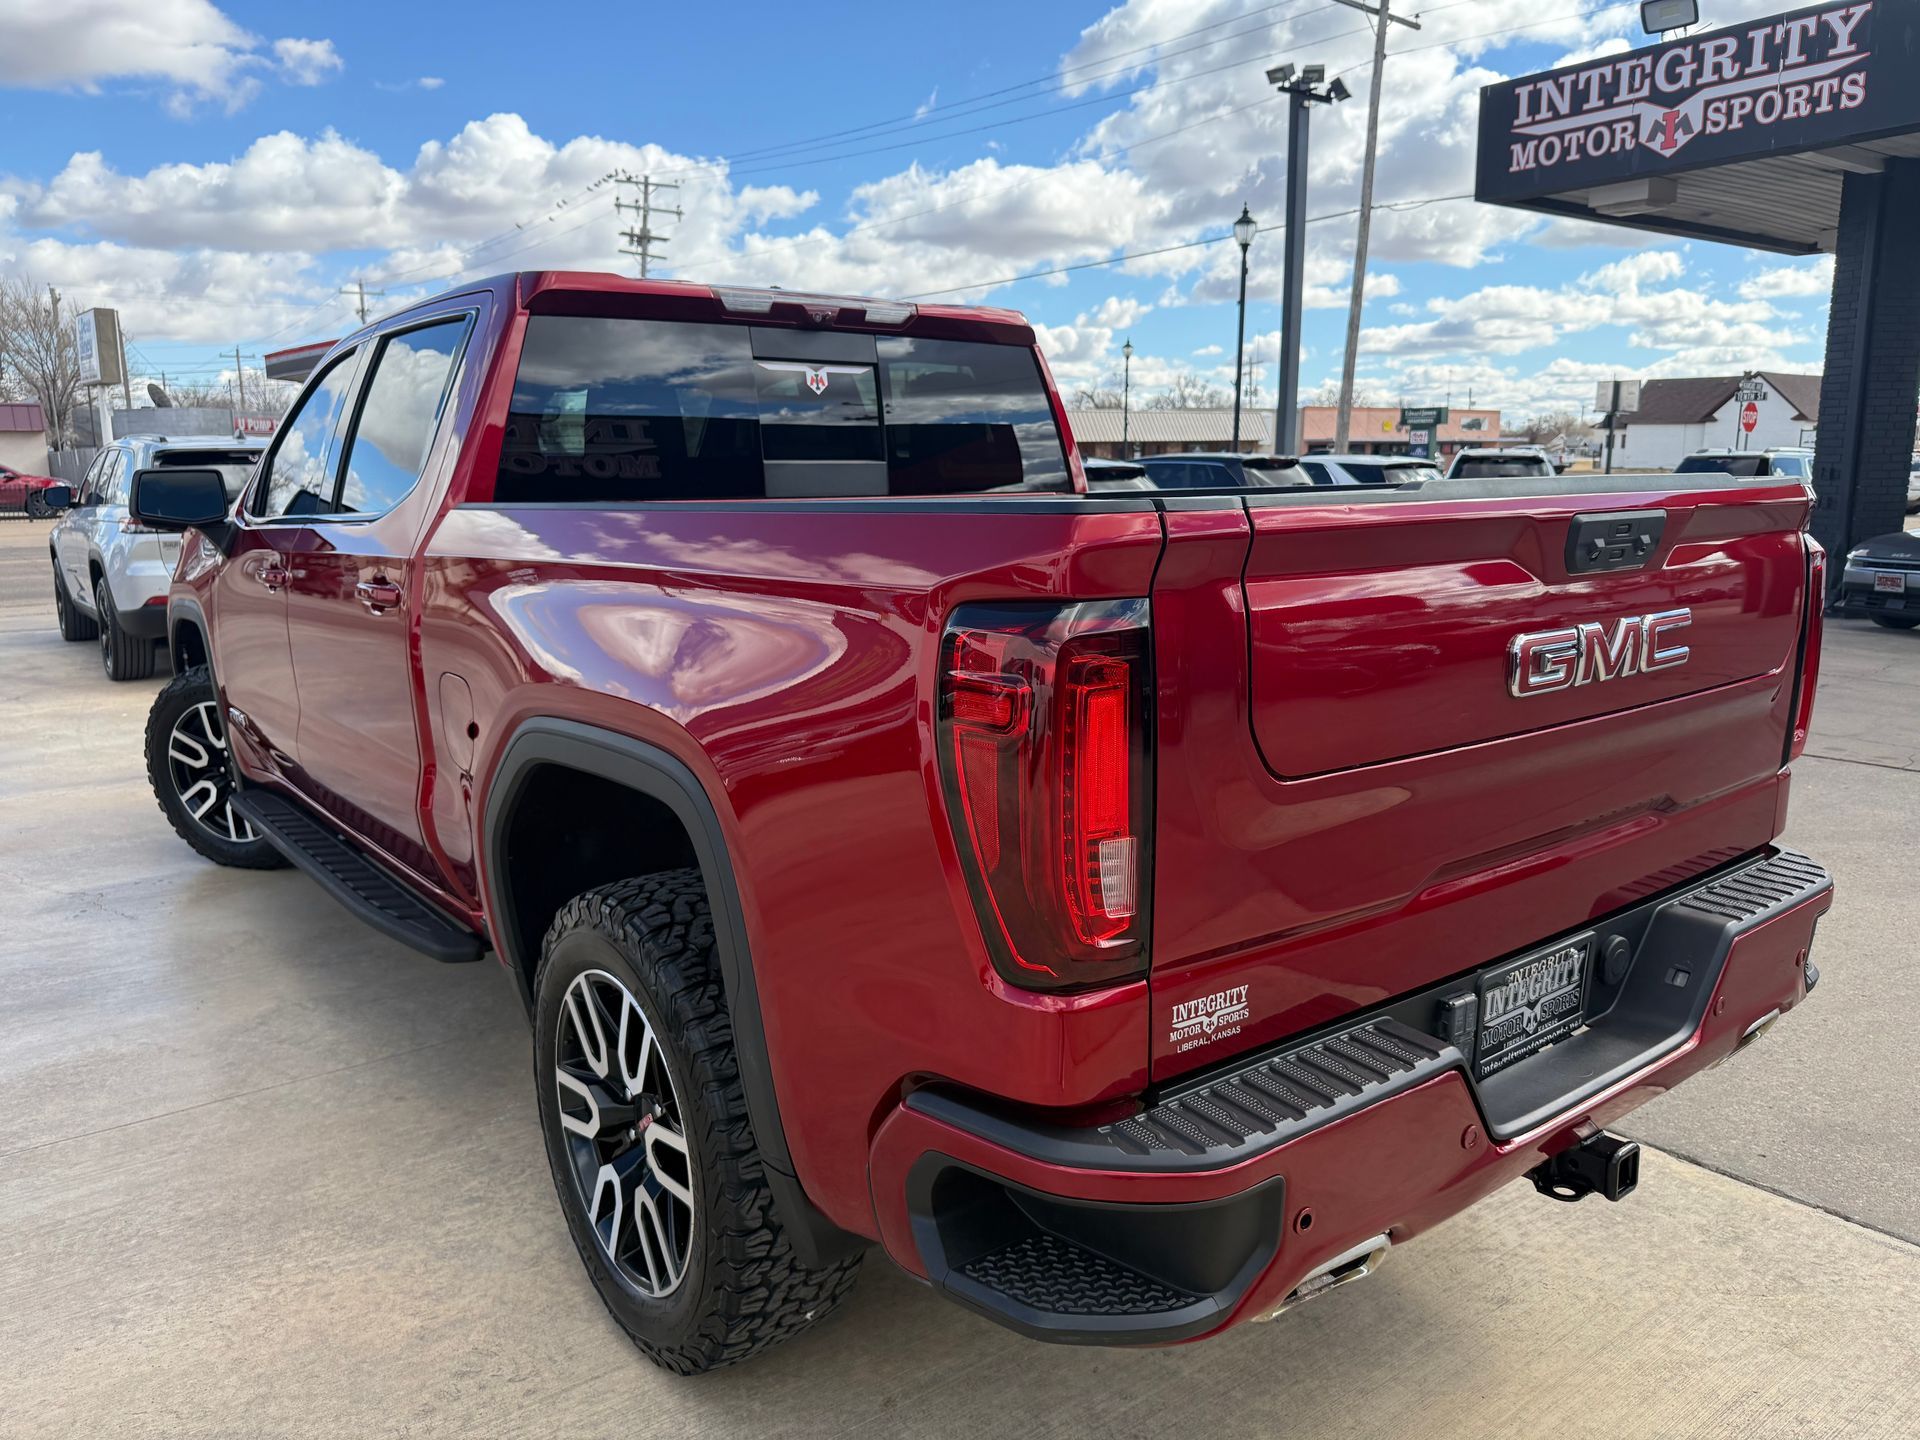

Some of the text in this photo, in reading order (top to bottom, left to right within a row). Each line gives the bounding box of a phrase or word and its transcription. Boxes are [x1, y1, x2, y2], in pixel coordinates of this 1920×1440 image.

[1513, 2, 1874, 127] INTEGRITY
[1508, 72, 1867, 173] MOTOR SPORTS
[248, 418, 272, 431] PUMP
[1743, 411, 1757, 424] STOP
[1507, 607, 1692, 698] GMC
[1172, 984, 1249, 1024] INTEGRITY
[1484, 950, 1586, 1021] INTEGRITY
[1169, 1008, 1250, 1043] MOTOR SPORTS
[1211, 1025, 1241, 1042] KANSAS
[1481, 987, 1581, 1050] MOTOR SPORTS
